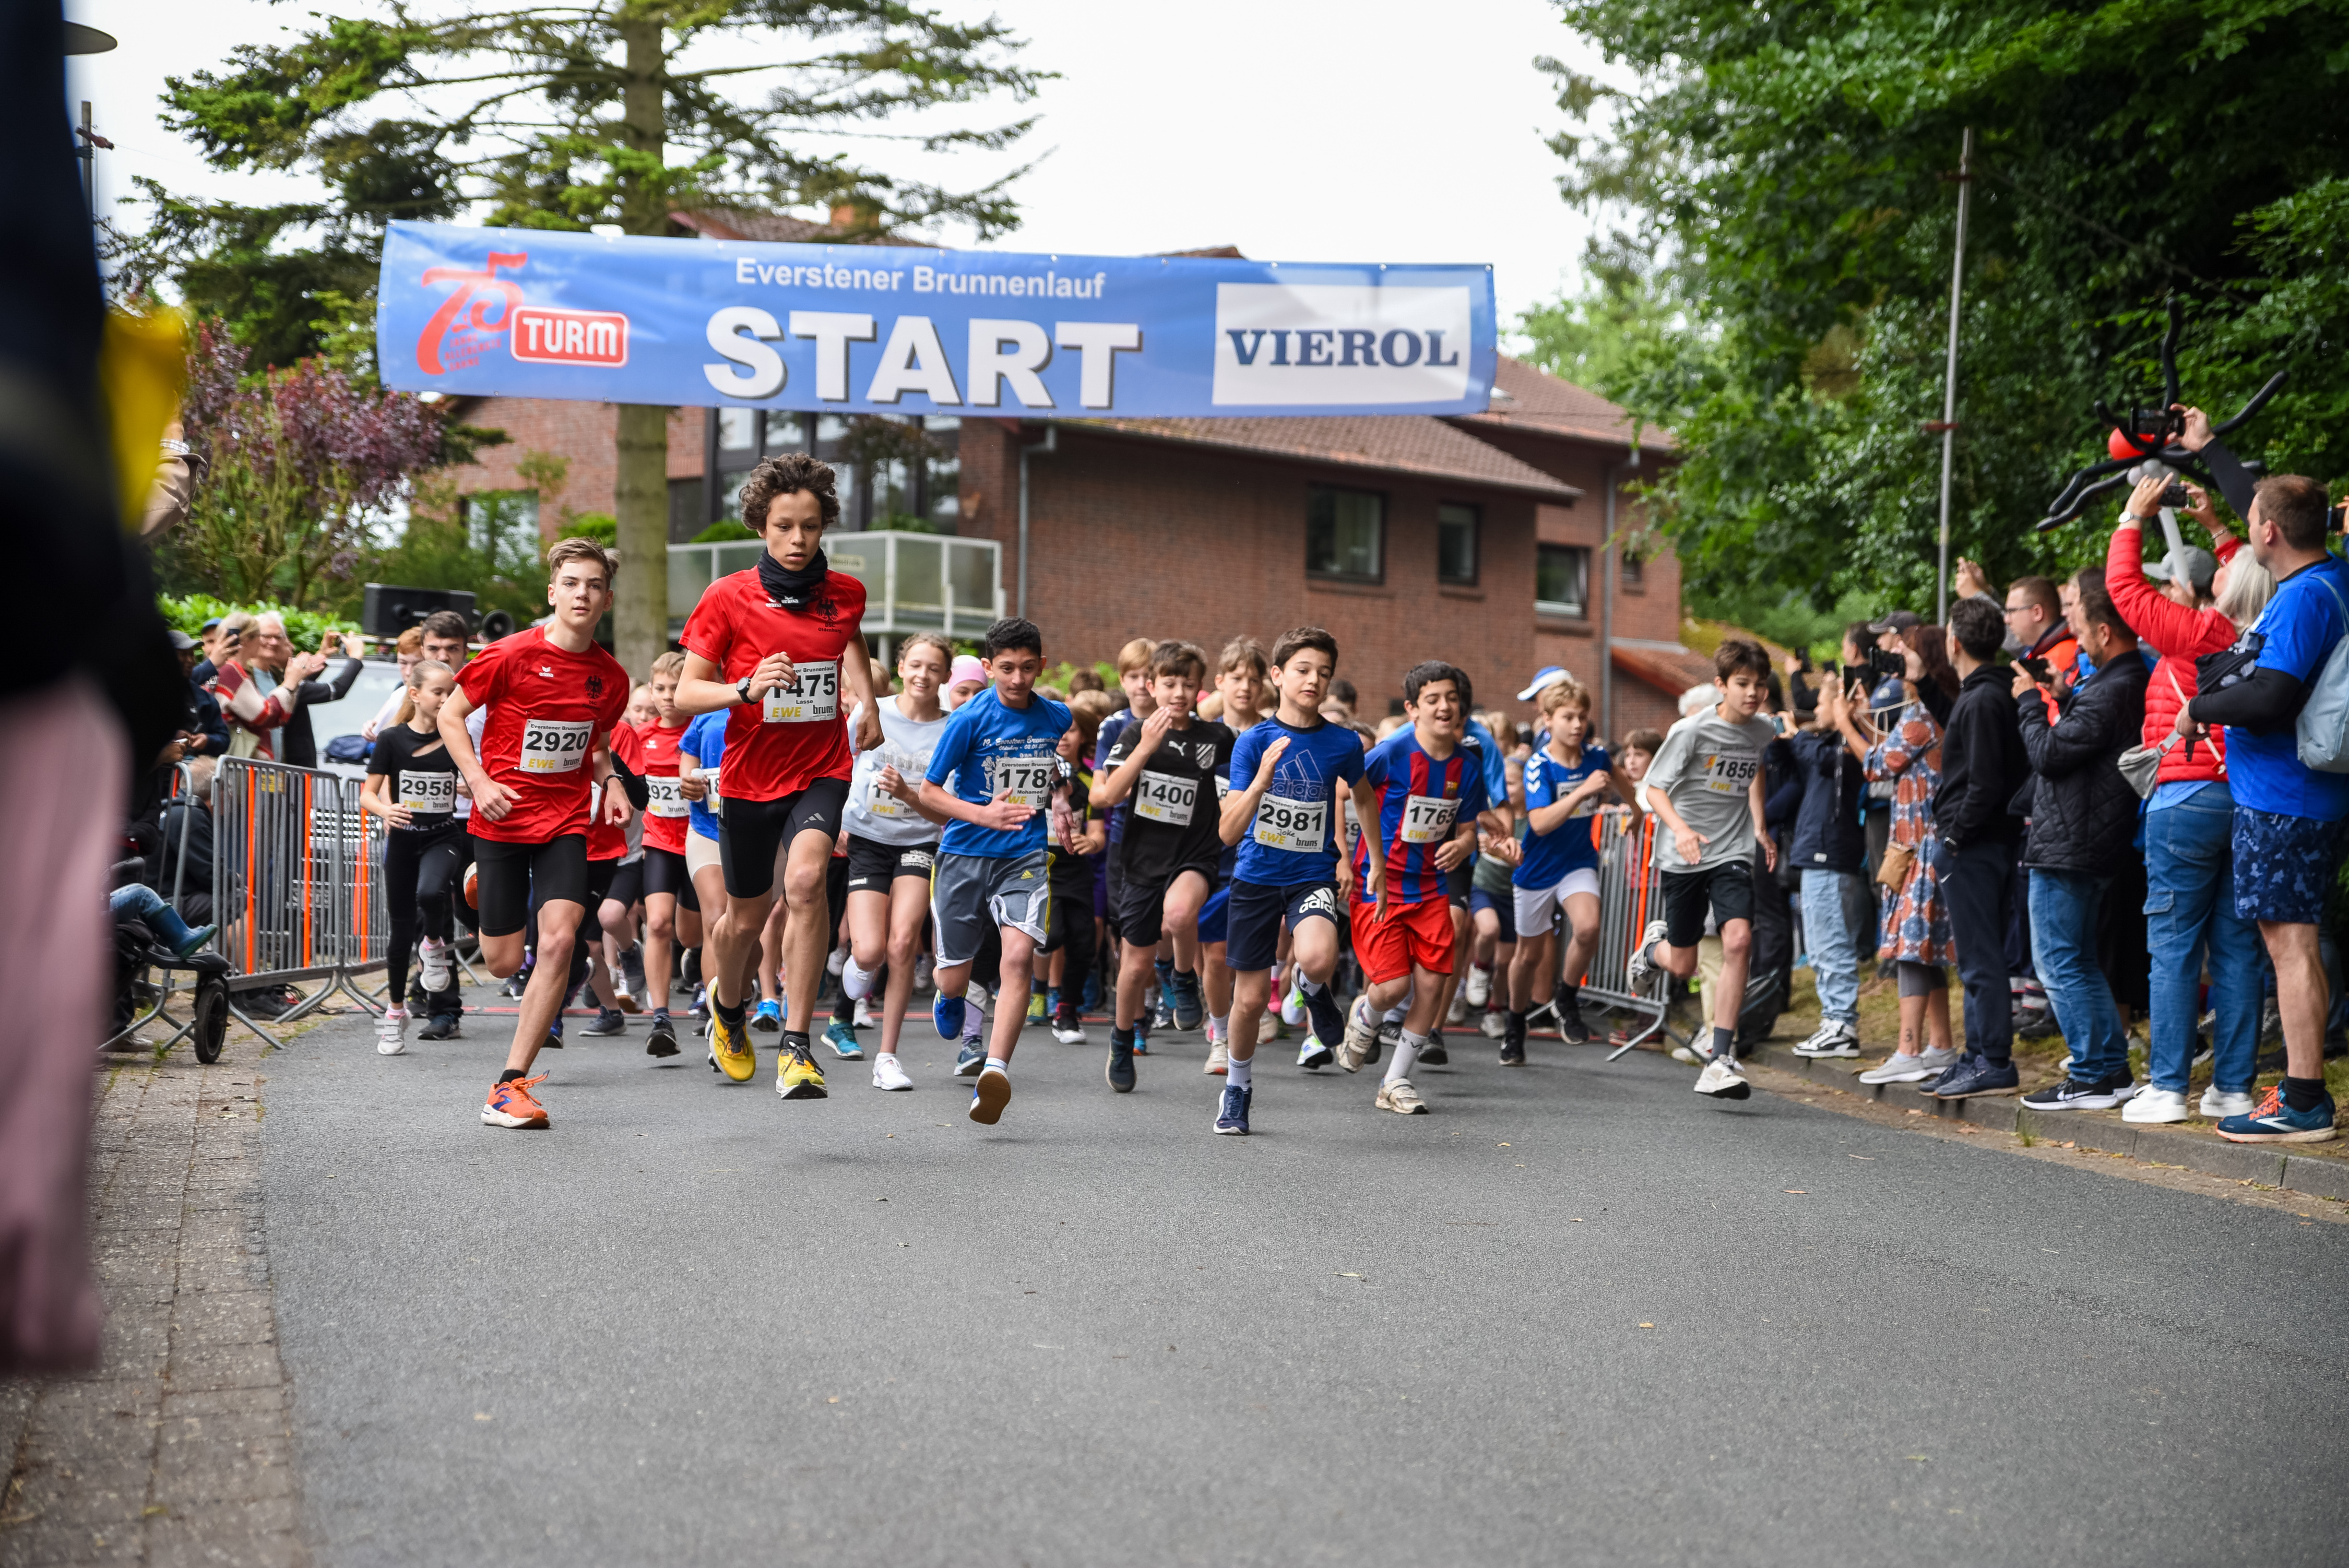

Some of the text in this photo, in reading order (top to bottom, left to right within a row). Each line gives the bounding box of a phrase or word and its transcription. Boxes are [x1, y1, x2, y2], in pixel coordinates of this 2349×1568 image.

[735, 257, 1106, 299] Everstener Brunnenlauf
[417, 252, 527, 375] 75
[523, 316, 617, 357] TURM
[703, 306, 1141, 408] START
[1226, 328, 1459, 367] VIEROL
[772, 706, 802, 718] EWE
[813, 705, 834, 715] bruns
[525, 730, 589, 752] 2920
[528, 758, 555, 769] EWE
[563, 758, 580, 766] bruns
[1716, 760, 1757, 779] 1856
[401, 779, 453, 796] 2958
[1141, 780, 1194, 806] 1400
[1265, 780, 1328, 801] didas
[872, 804, 896, 814] EWE
[1006, 795, 1027, 804] WE
[1265, 797, 1292, 809] Everstener
[1140, 803, 1161, 817] EWE
[1259, 803, 1322, 831] 2981
[1410, 805, 1457, 825] 1765
[1259, 830, 1287, 845] EWE
[1296, 837, 1319, 847] bruns
[1298, 898, 1337, 922] adida
